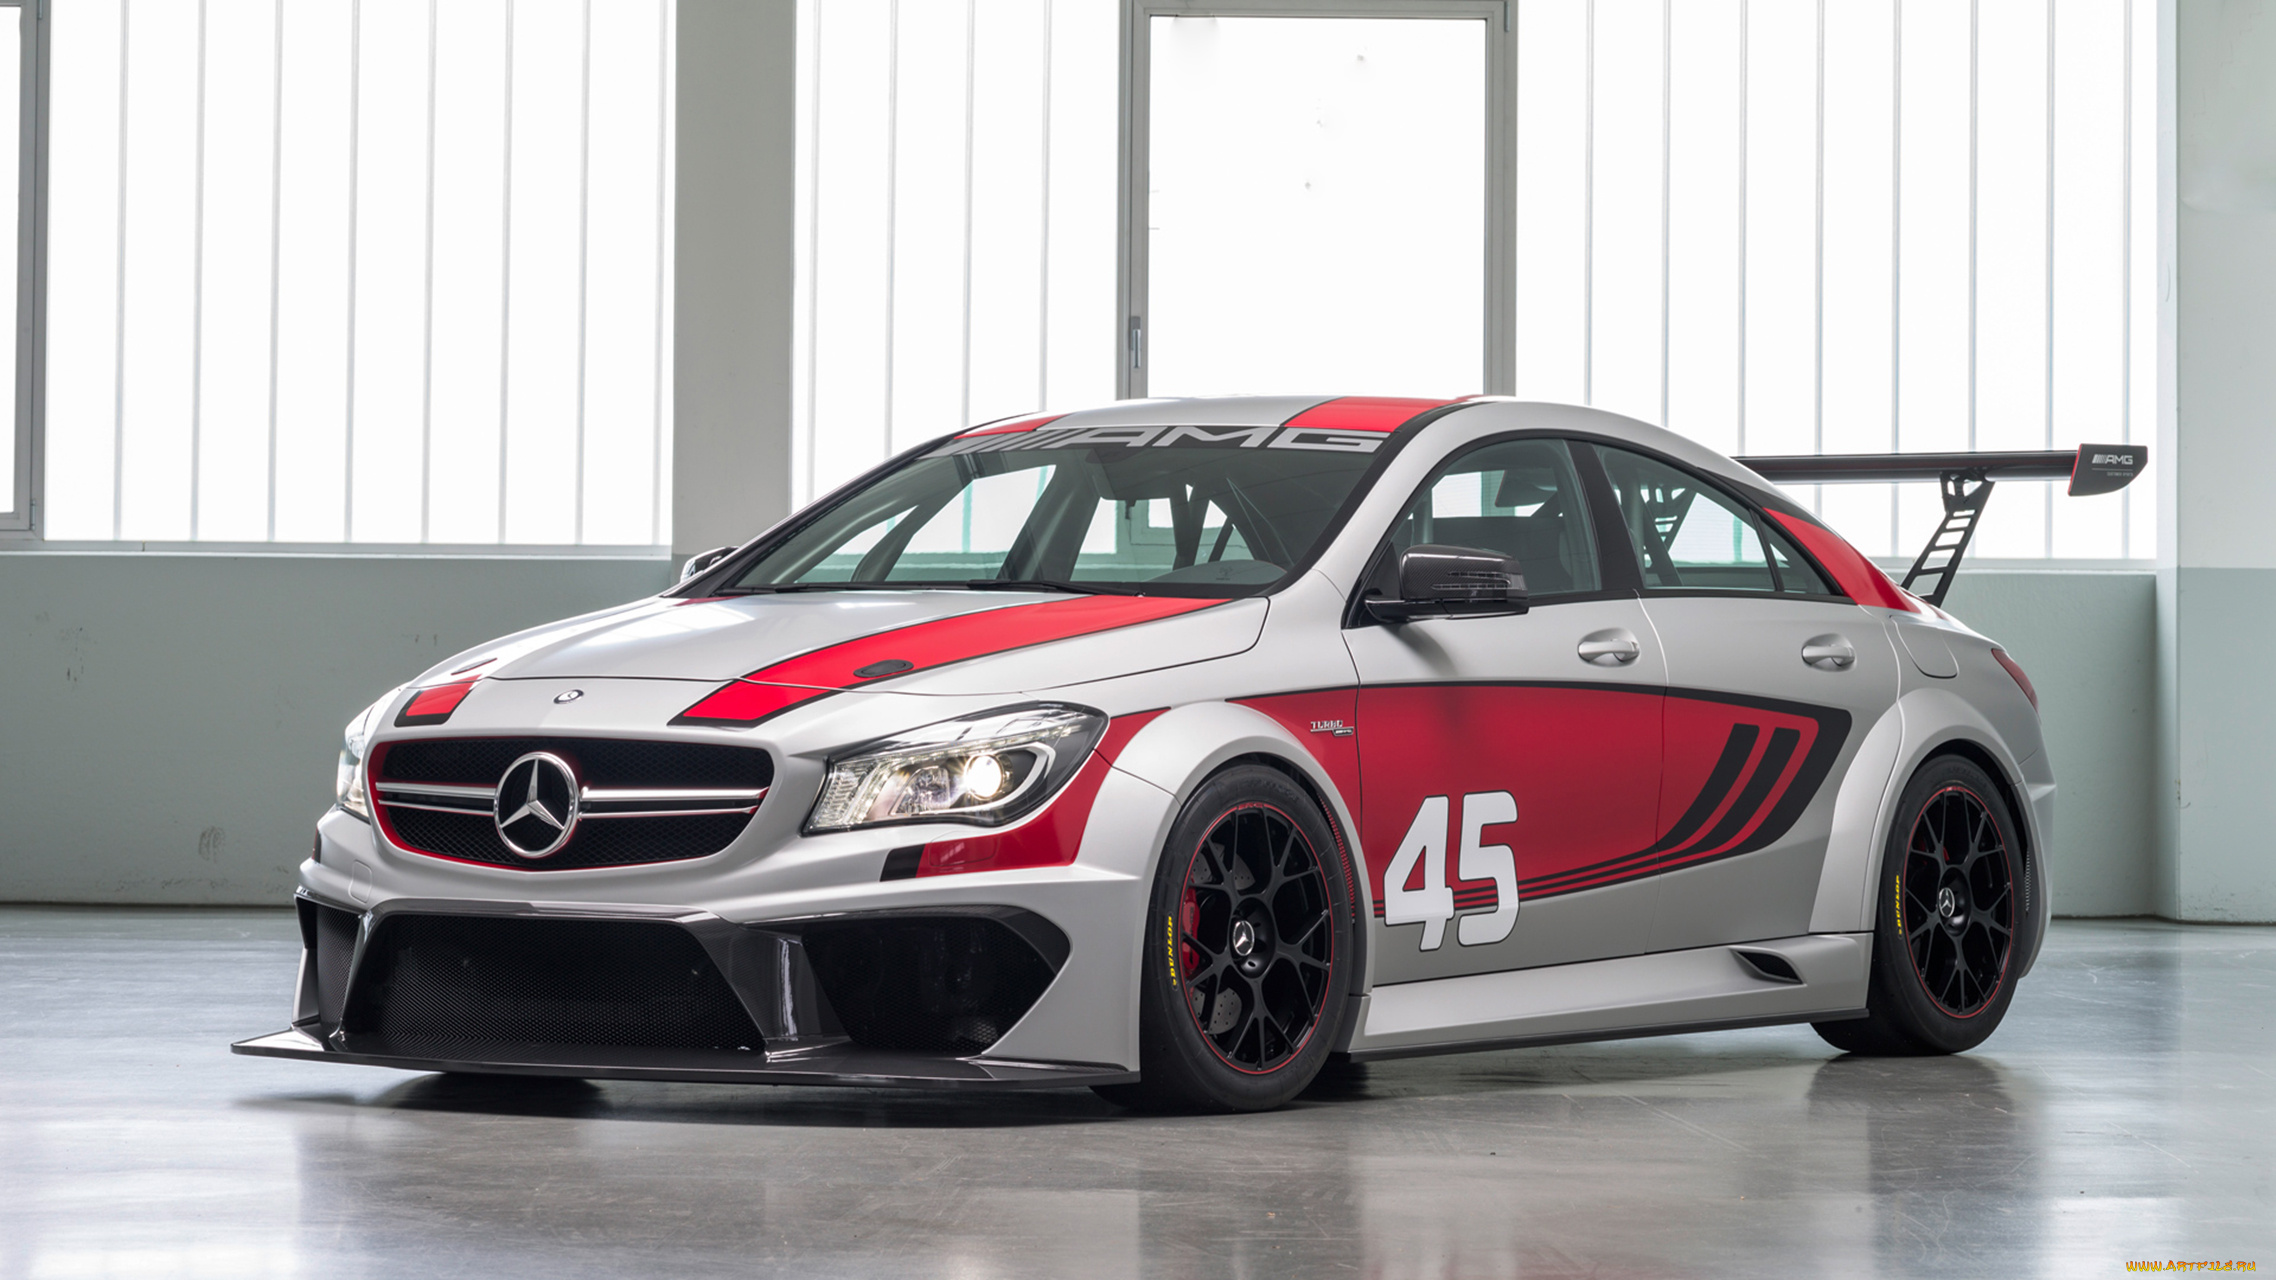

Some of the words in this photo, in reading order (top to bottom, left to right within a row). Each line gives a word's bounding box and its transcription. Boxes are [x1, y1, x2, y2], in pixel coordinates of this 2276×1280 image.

[1039, 425, 1391, 453] AMG
[2104, 454, 2134, 465] AMG
[1310, 719, 1343, 729] TURBO
[1383, 789, 1521, 953] 45
[1167, 915, 1177, 978] DUNLOP
